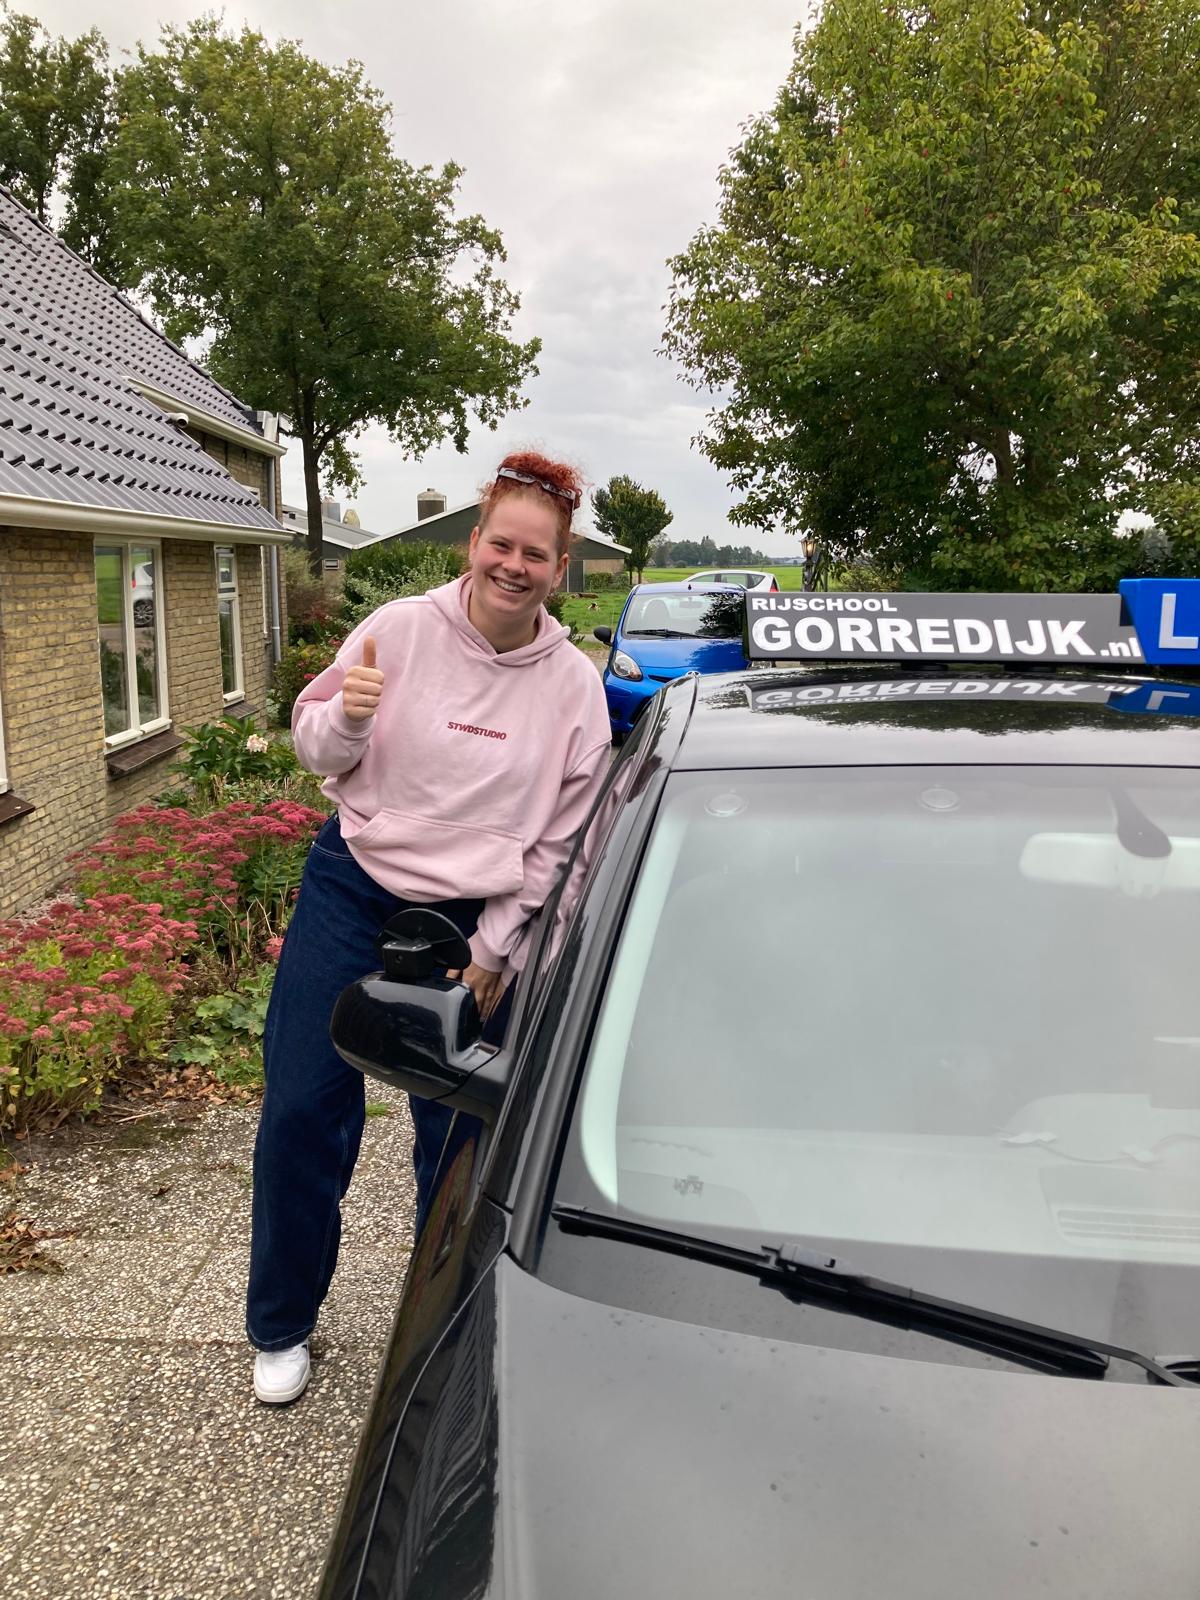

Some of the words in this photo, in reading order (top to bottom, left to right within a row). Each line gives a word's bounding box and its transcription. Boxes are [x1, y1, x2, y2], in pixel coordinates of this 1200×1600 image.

[752, 597, 897, 612] RIJSCHOOL
[1158, 593, 1199, 649] L
[447, 721, 507, 740] STWDSTUDIO
